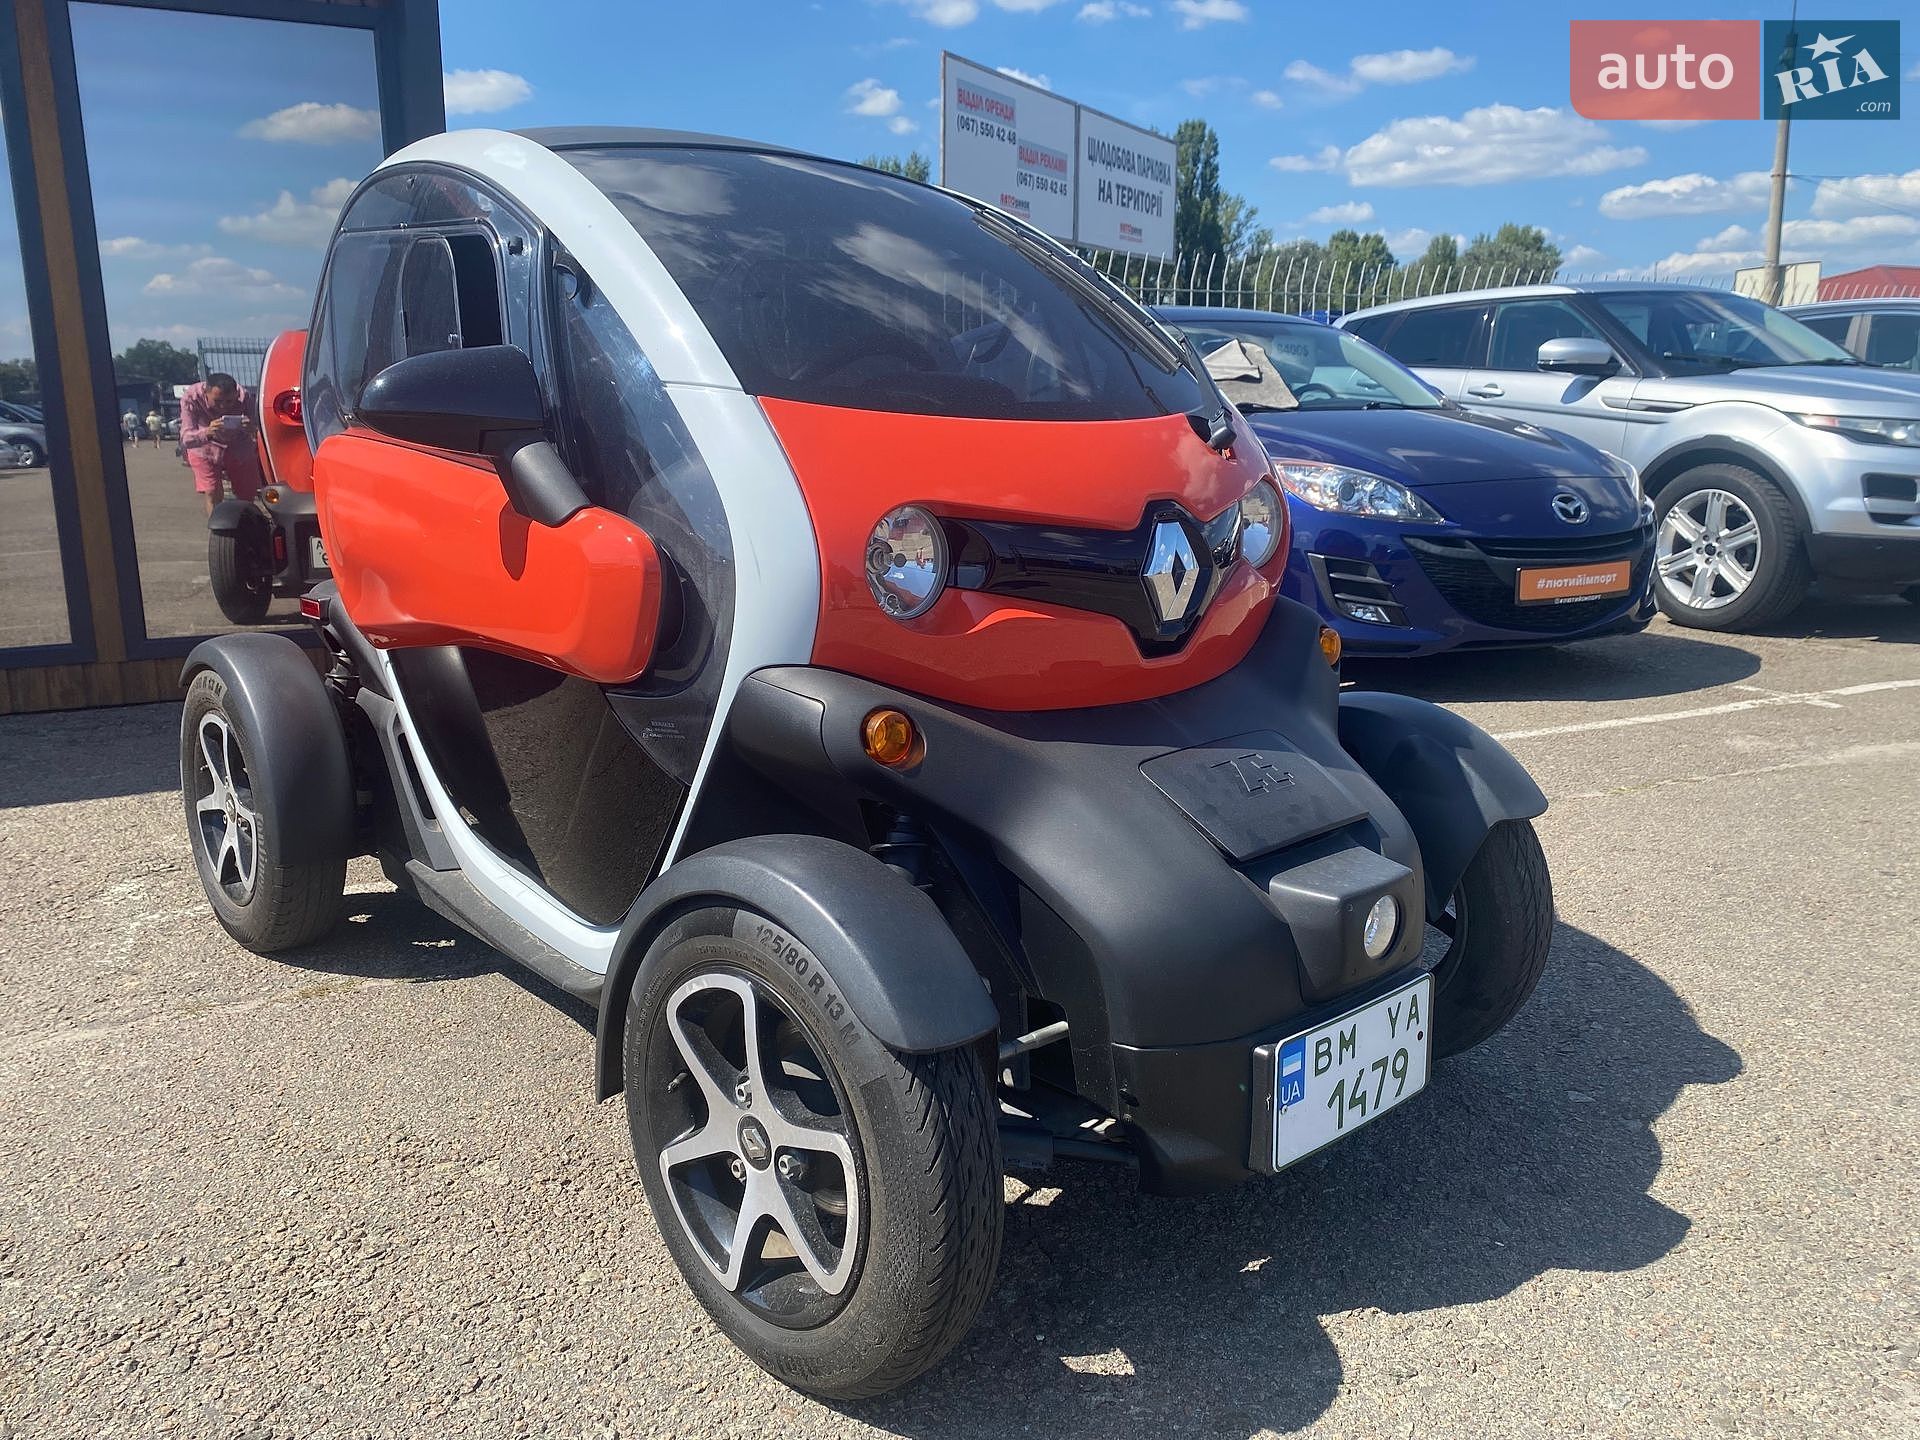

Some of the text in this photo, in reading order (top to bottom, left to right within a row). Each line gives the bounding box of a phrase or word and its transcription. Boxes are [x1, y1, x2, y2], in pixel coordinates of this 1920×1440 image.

[956, 114, 979, 136] (067)
[980, 121, 994, 138] 550
[995, 126, 1006, 142] 42
[1016, 169, 1035, 191] (067)
[1049, 180, 1058, 194] 42
[1098, 178, 1163, 217] НА ТЕРИТОРІЇ
[755, 924, 809, 976] 125/80
[808, 971, 826, 996] R
[824, 992, 845, 1021] 13
[1314, 993, 1420, 1078] BM YA
[1281, 1081, 1301, 1104] UA
[1327, 1047, 1409, 1130] 1479
